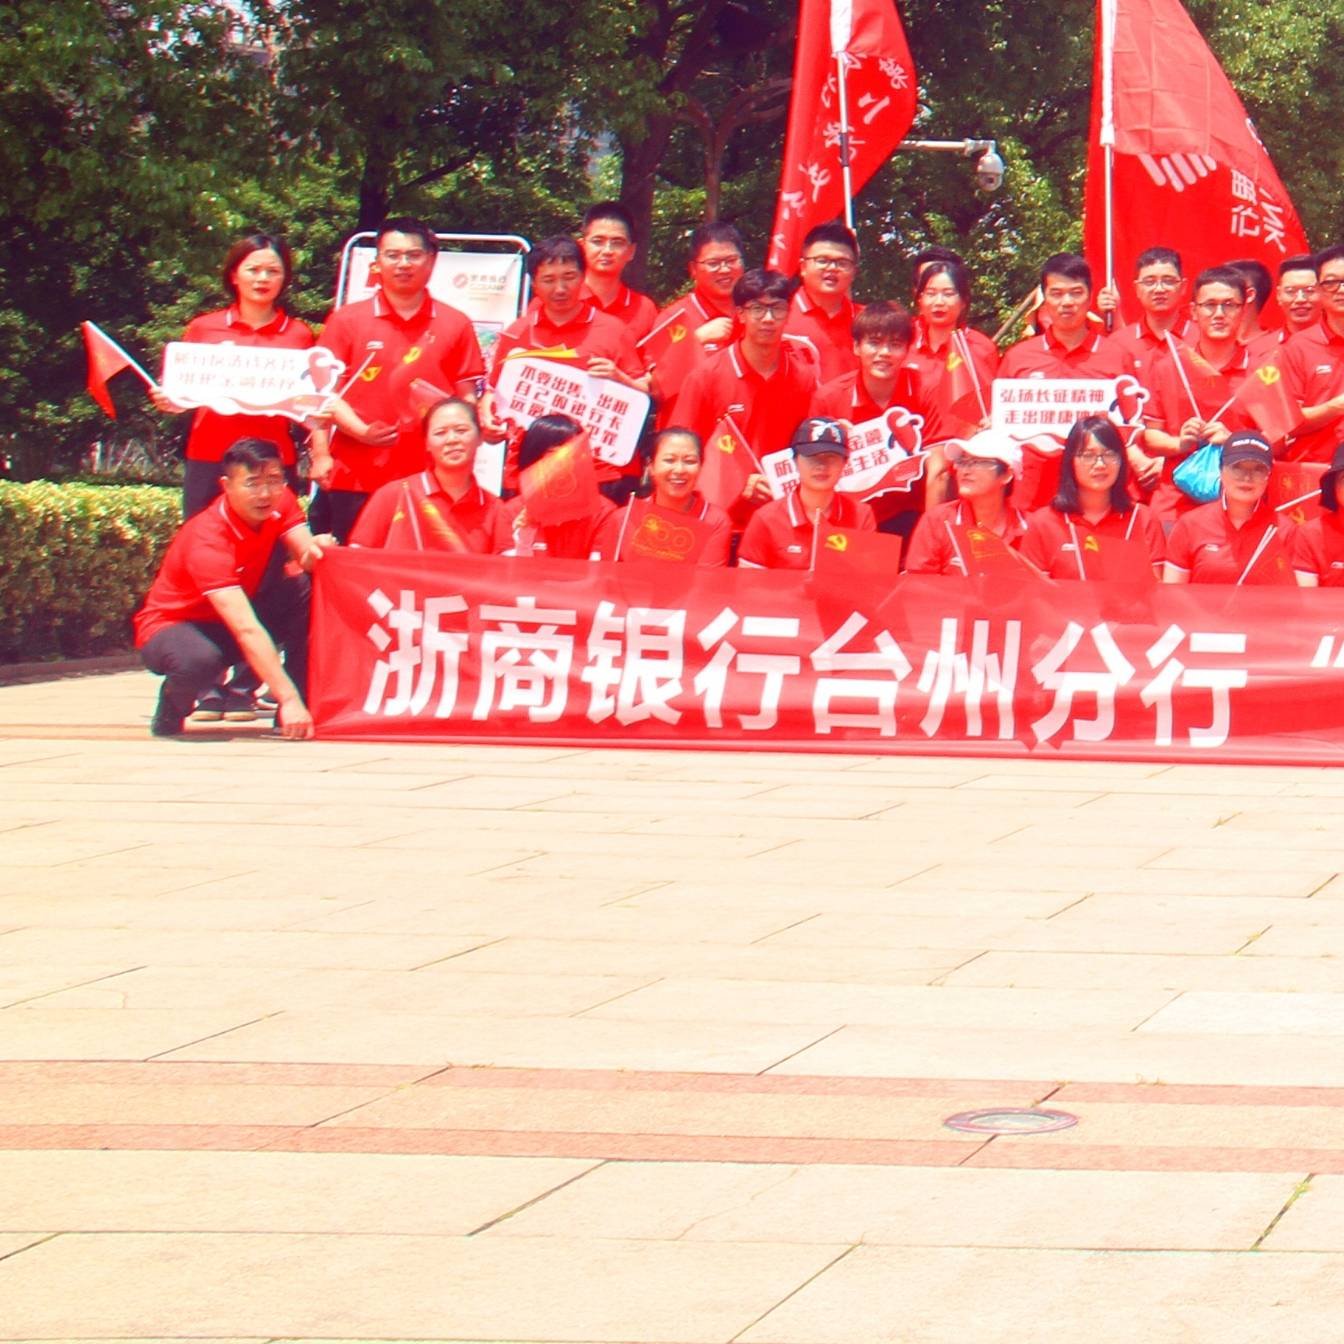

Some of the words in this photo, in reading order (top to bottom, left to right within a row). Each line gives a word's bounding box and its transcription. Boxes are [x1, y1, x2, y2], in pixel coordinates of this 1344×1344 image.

[514, 380, 623, 431] 自己的银行卡
[1000, 388, 1106, 403] 弘扬长征精神
[362, 588, 1249, 749] 浙商银行台州分行
